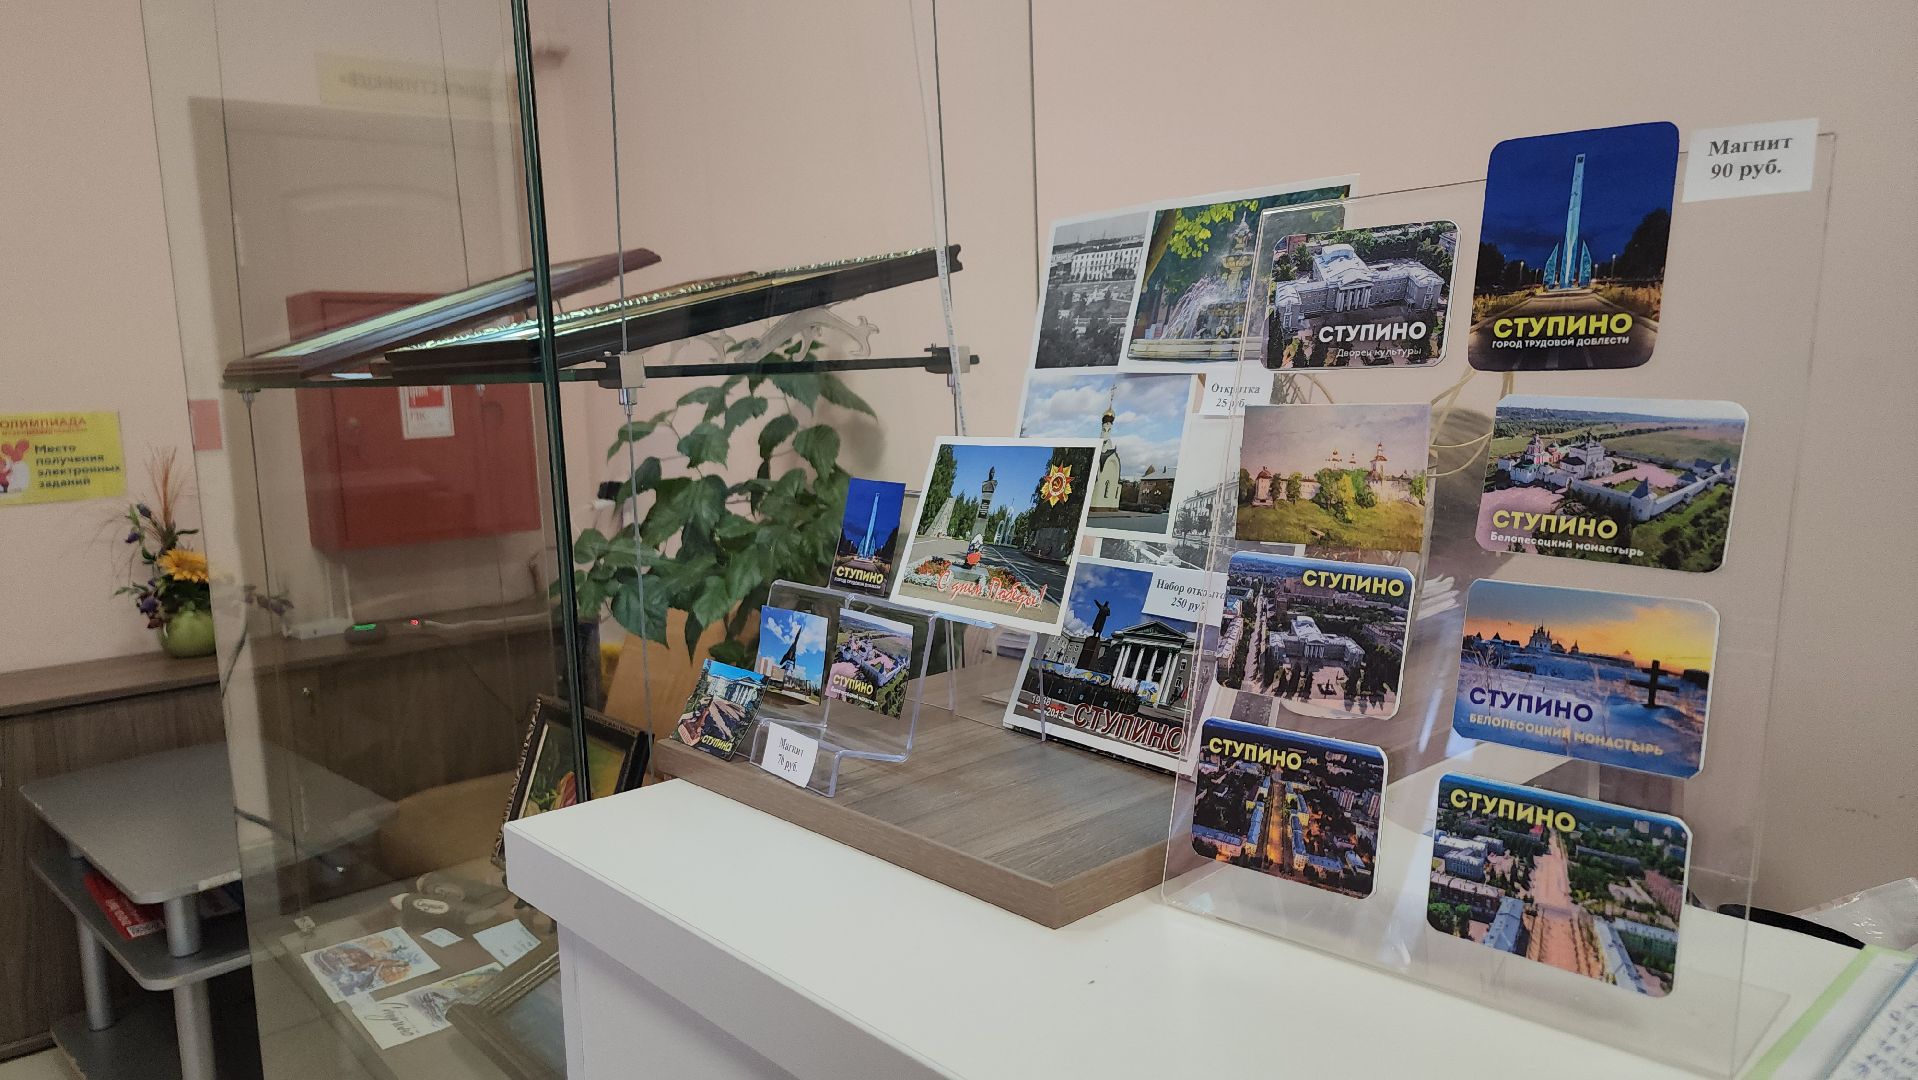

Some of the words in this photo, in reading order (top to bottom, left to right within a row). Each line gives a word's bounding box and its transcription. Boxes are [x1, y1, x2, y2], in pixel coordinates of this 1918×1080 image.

[1707, 137, 1794, 156] Магнит
[1710, 162, 1734, 180] 90
[1739, 158, 1782, 181] руб.
[1318, 321, 1427, 343] СТУПИНО
[1493, 313, 1633, 339] СТУПИНО
[1492, 339, 1523, 349] ГОРОД
[1524, 337, 1575, 349] ТРУДОВОЙ
[1576, 336, 1630, 348] ДОБЛЕСТИ
[1336, 347, 1373, 359] Дворец
[1374, 347, 1422, 358] культуры
[1211, 383, 1261, 396] Откртка
[1216, 398, 1228, 408] 25
[34, 444, 77, 454] Место
[36, 454, 105, 466] получения
[38, 466, 120, 477] электронных
[39, 477, 91, 489] заданий
[1492, 509, 1619, 540] СТУПИНО
[1490, 531, 1574, 550] Белопесоцкий
[1575, 543, 1645, 558] монастырь
[836, 565, 884, 585] СТУПИНО
[937, 569, 953, 592] С
[1302, 569, 1405, 597] СТУПИНО
[1156, 578, 1185, 595] Набор
[1170, 596, 1188, 609] 250
[833, 674, 874, 695] СТУПИНО
[1045, 707, 1065, 720] 2013
[1469, 686, 1594, 723] СТУПИНО
[1072, 702, 1188, 754] СТУПИНО
[1469, 713, 1571, 740] БЕЛОПЕСОЦКИЙ
[1573, 732, 1665, 757] МОНАСТЫРЬ
[701, 735, 733, 752] СТУПИНО
[779, 736, 804, 757] Магнит
[1208, 737, 1303, 771] СТУПИНО
[1450, 788, 1577, 833] СТУПИНО
